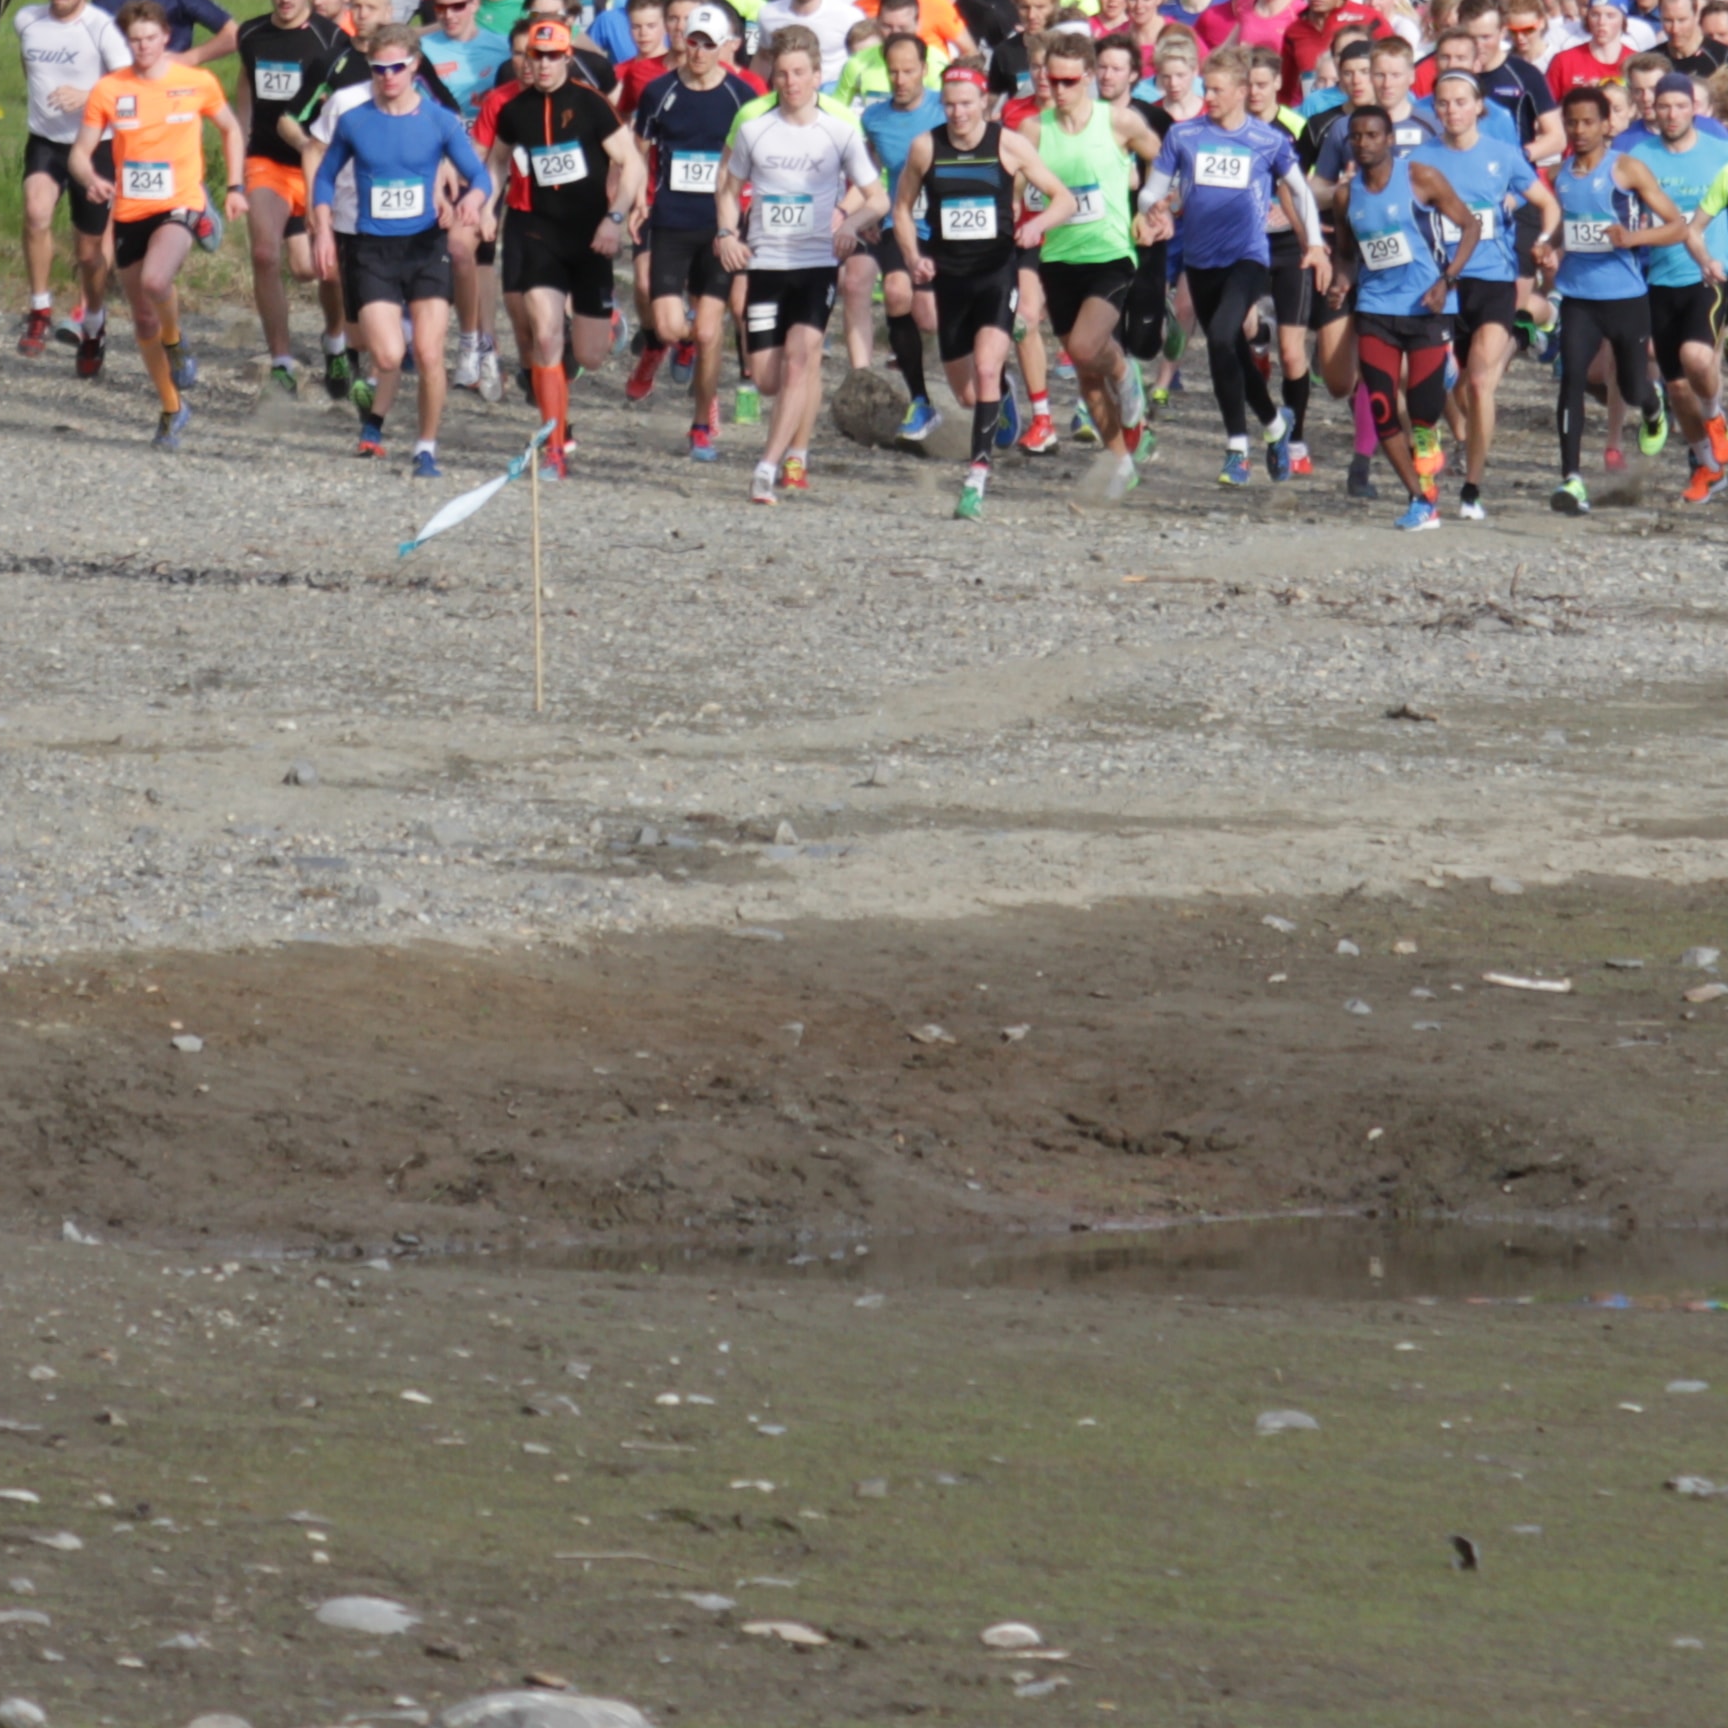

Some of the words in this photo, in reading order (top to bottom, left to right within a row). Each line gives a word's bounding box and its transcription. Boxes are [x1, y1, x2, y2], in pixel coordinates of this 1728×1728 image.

[263, 73, 292, 92] 217
[539, 154, 577, 176] 236
[682, 163, 714, 181] 197
[1204, 156, 1241, 177] 249
[129, 170, 164, 190] 234
[380, 190, 415, 209] 219
[770, 206, 806, 224] 207
[949, 210, 987, 230] 226
[1571, 223, 1604, 242] 135
[1367, 239, 1401, 260] 299
